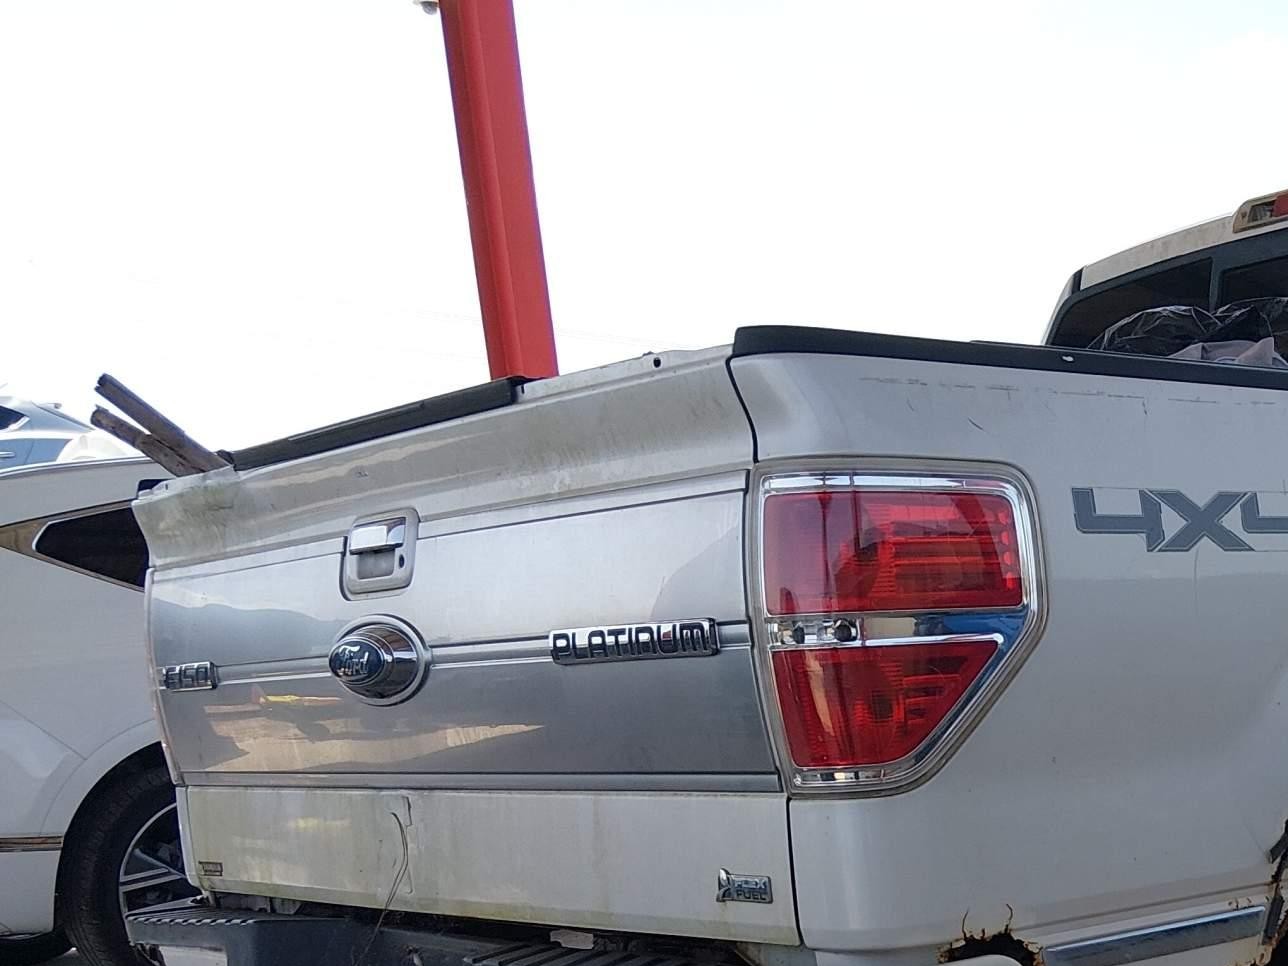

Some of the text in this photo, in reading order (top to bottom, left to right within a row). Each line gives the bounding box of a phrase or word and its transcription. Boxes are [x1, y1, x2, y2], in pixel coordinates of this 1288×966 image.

[552, 622, 710, 661] PLATINUM
[338, 645, 370, 675] Ford
[734, 878, 766, 889] FLEX
[736, 890, 767, 901] FUEL
